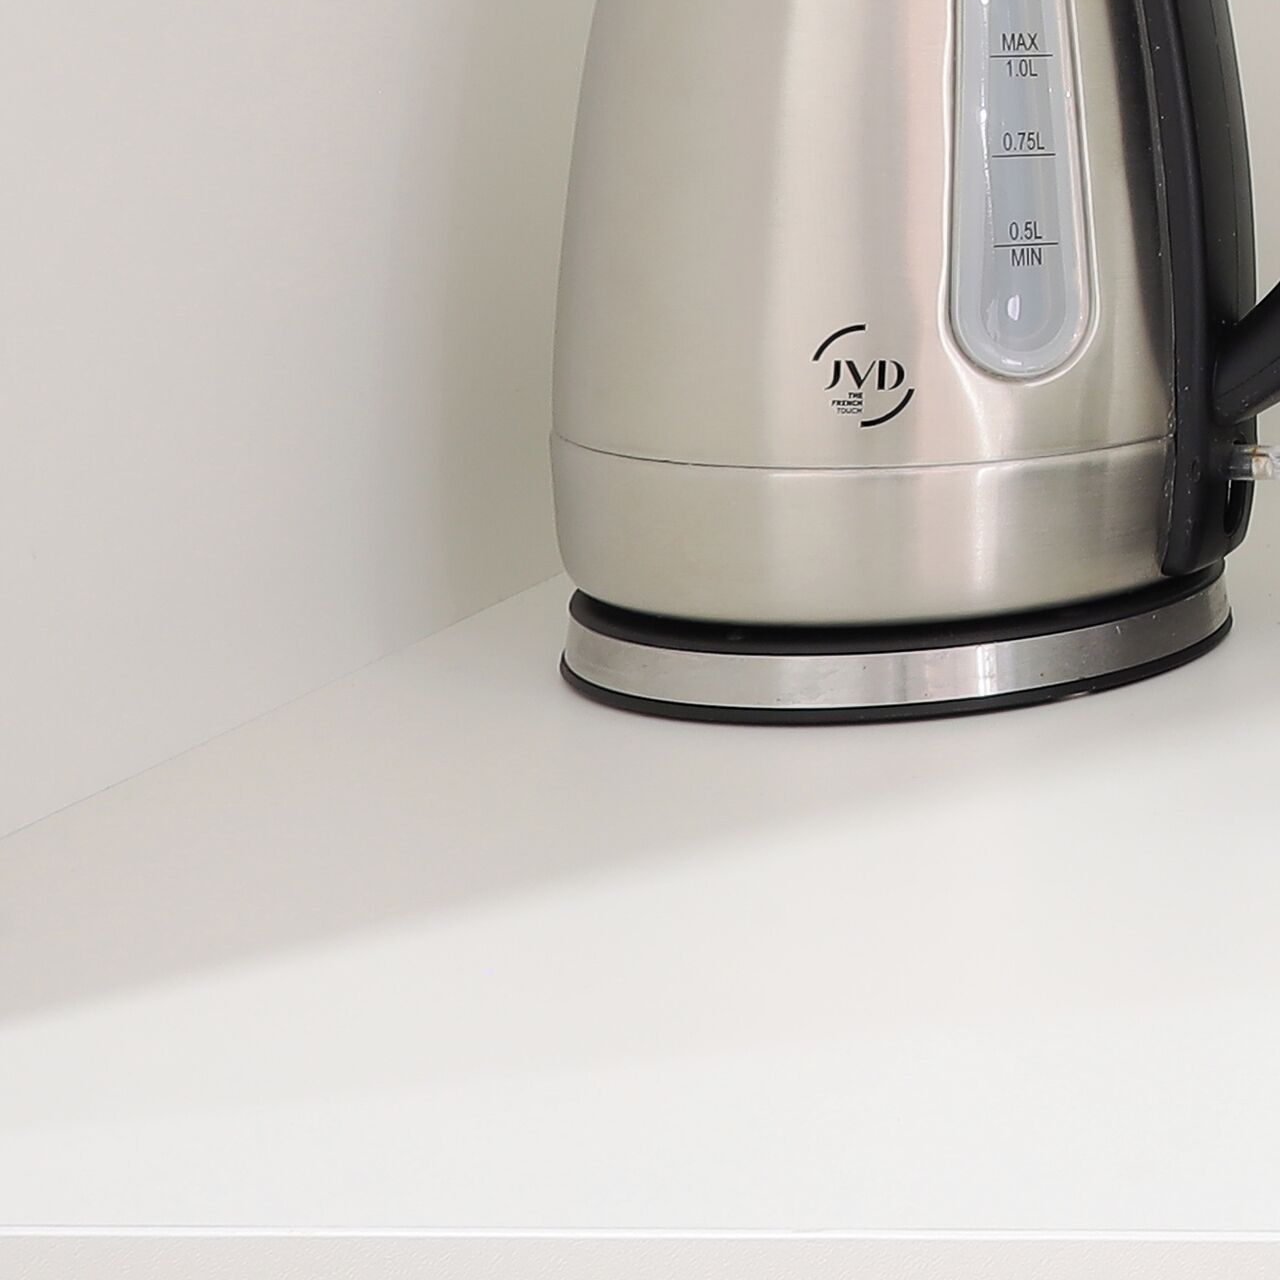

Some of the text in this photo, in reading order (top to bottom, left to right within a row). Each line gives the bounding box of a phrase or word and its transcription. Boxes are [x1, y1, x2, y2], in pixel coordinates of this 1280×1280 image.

[1001, 33, 1039, 51] MAX
[1006, 59, 1038, 77] 1.0L
[1003, 132, 1045, 151] 0.75L
[1009, 221, 1043, 240] 0.5L
[1011, 248, 1042, 266] MIN
[824, 360, 905, 391] JVD
